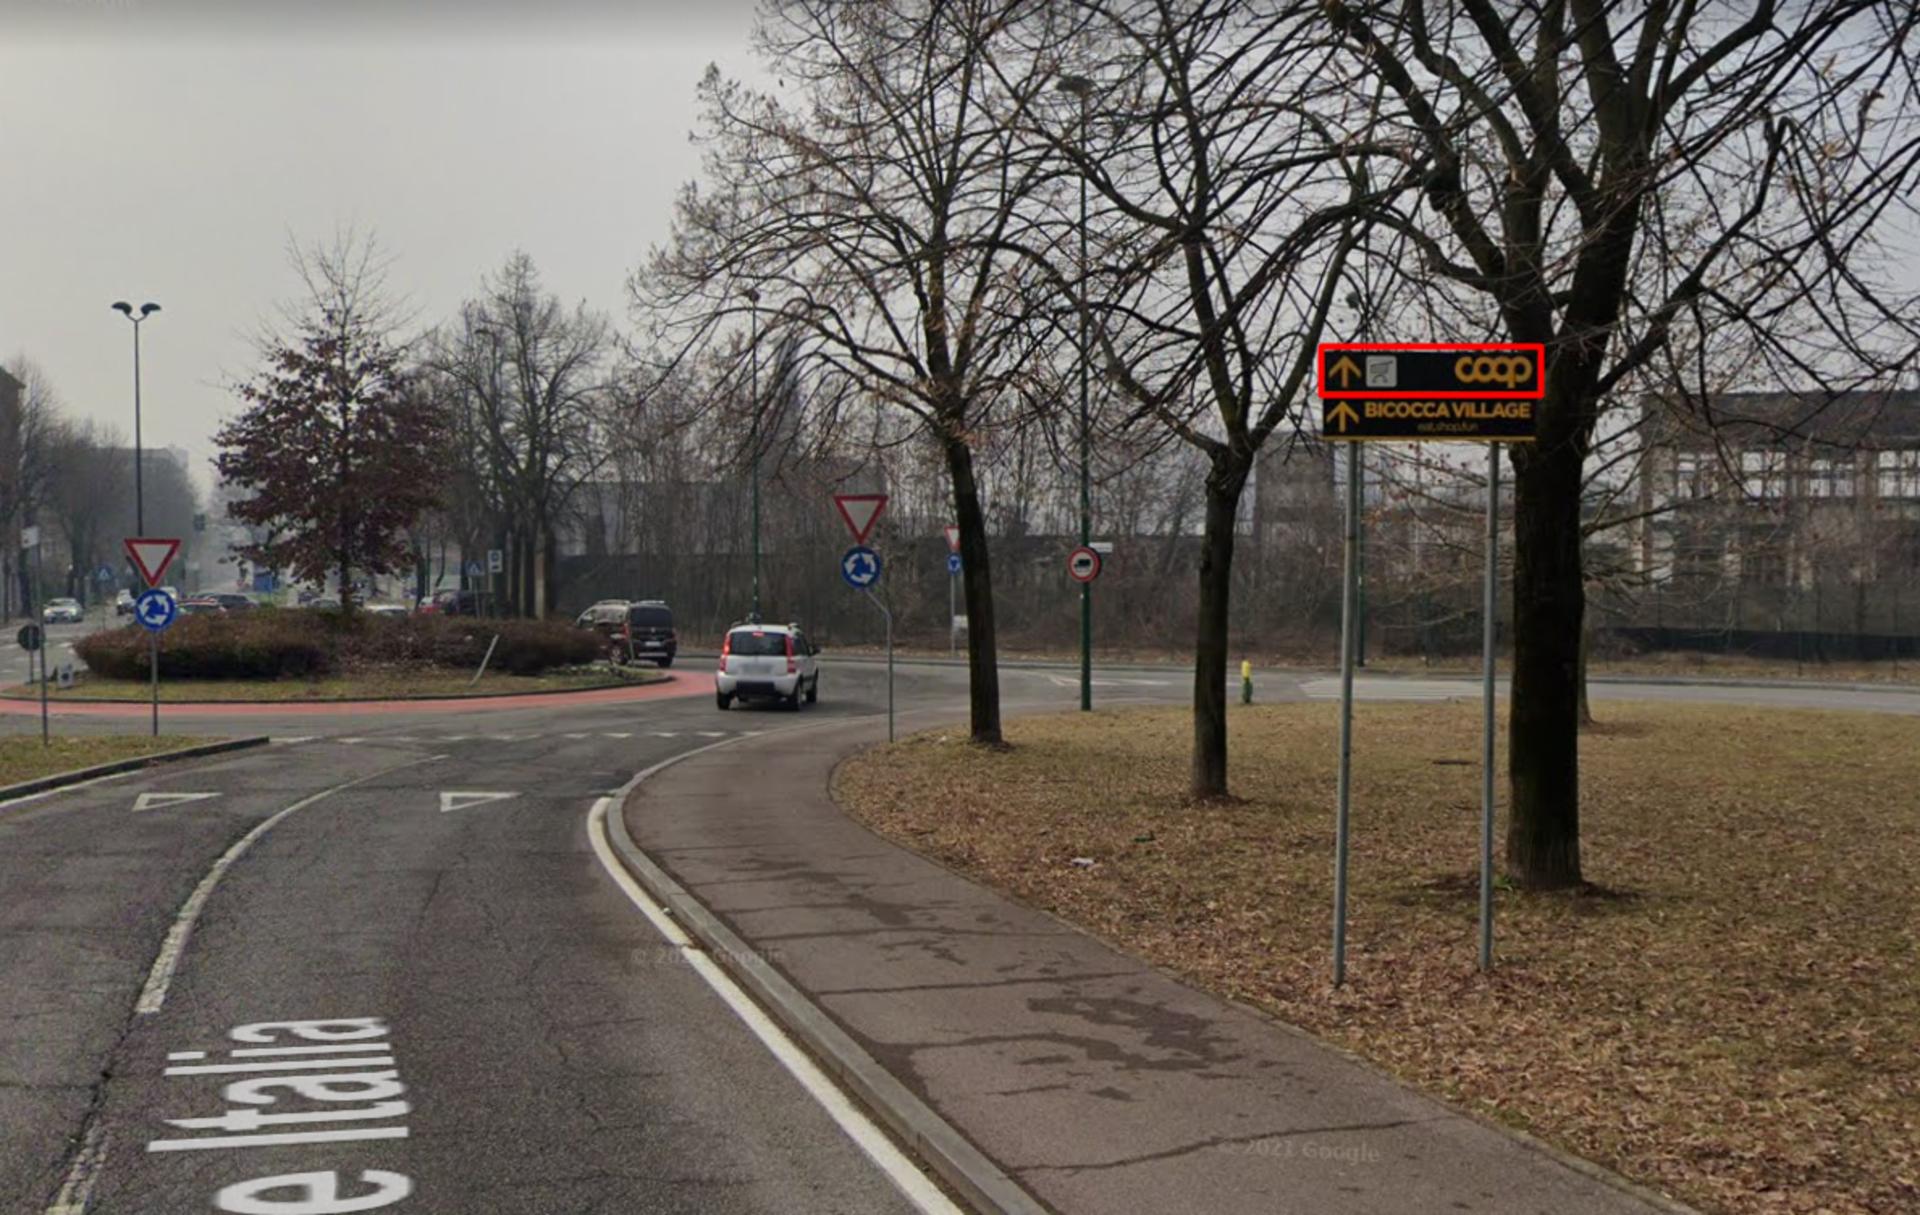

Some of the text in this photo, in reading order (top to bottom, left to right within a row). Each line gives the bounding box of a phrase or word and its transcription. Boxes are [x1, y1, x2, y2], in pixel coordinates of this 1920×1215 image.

[1455, 355, 1533, 388] coop
[1364, 402, 1531, 418] BICOCCA VILLAGE
[146, 1017, 412, 1153] Italia
